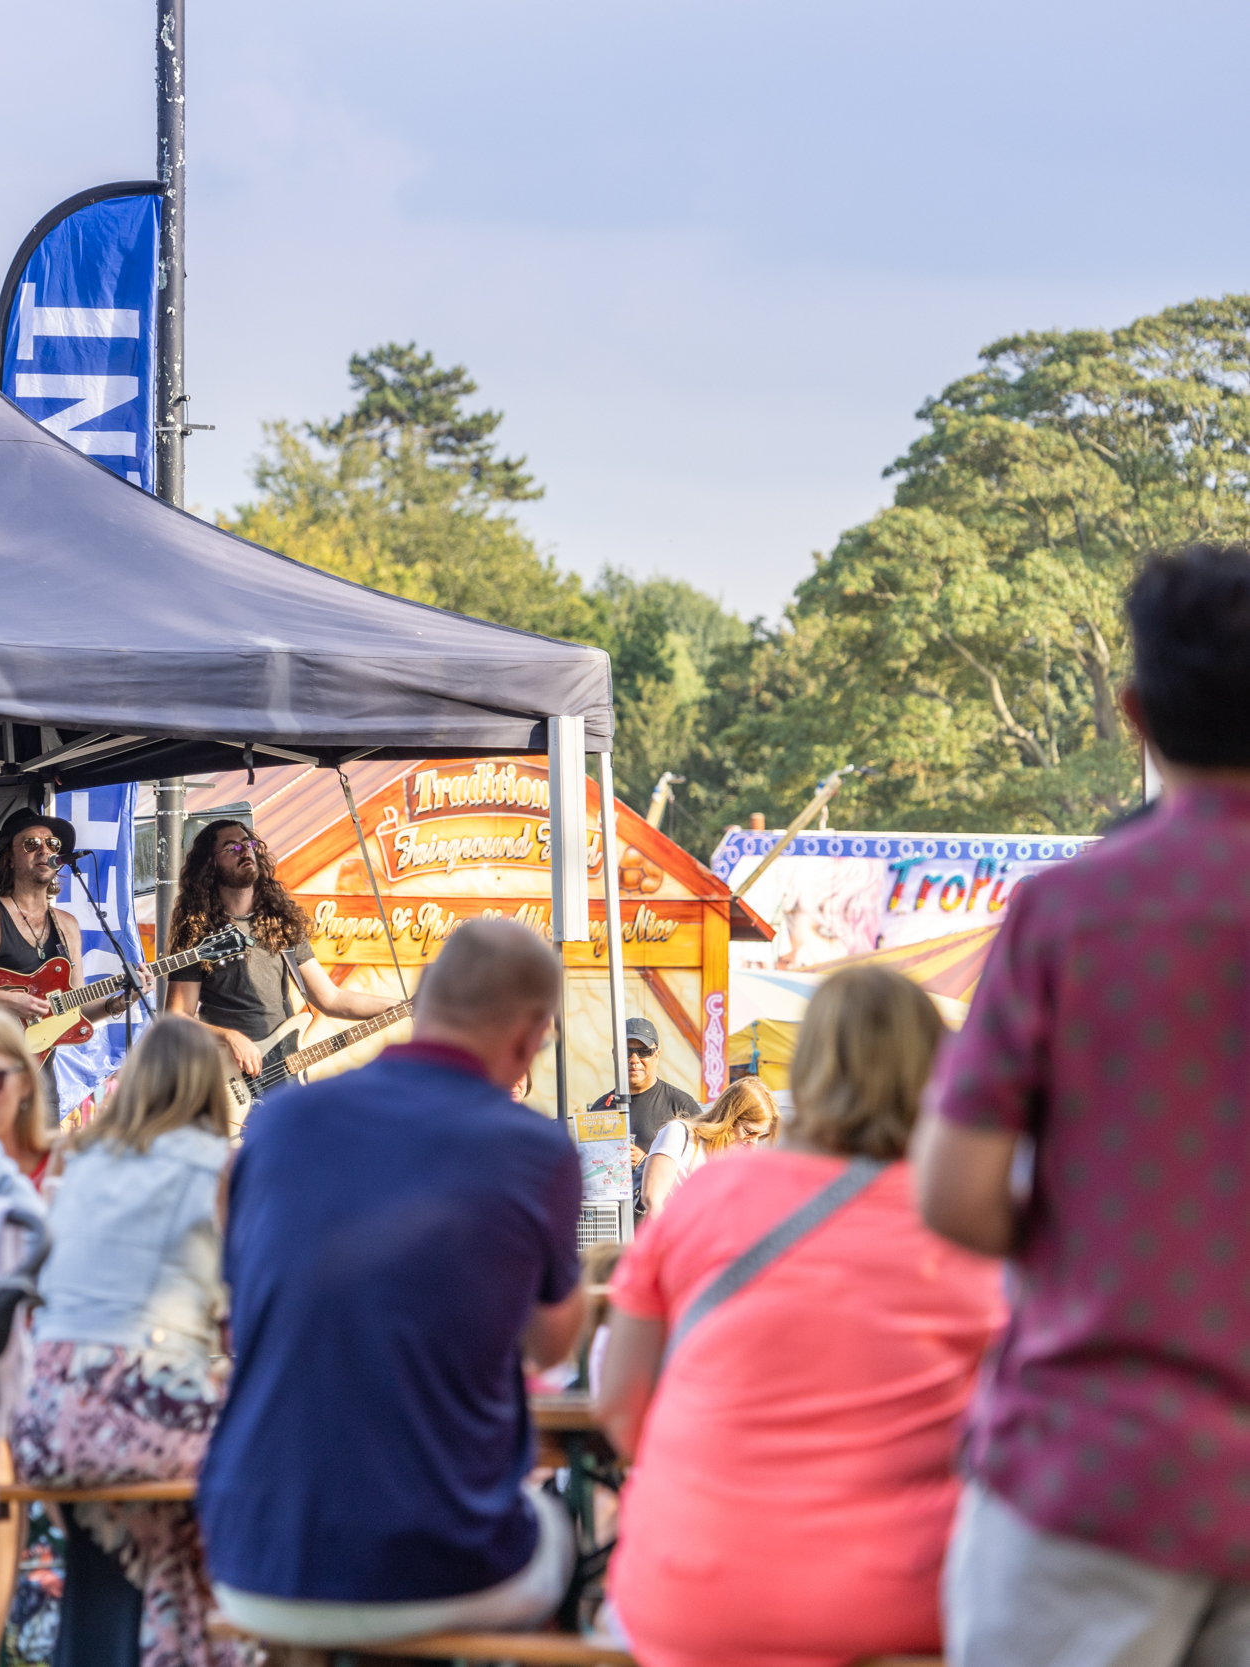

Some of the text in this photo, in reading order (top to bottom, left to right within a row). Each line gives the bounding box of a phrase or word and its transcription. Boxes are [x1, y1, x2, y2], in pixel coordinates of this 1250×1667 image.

[394, 823, 533, 873] Fairground
[313, 900, 385, 954] Sugar
[391, 907, 413, 940] &
[411, 902, 471, 956] Spic
[705, 993, 725, 1099] CANDY
[586, 1122, 617, 1137] Festival
